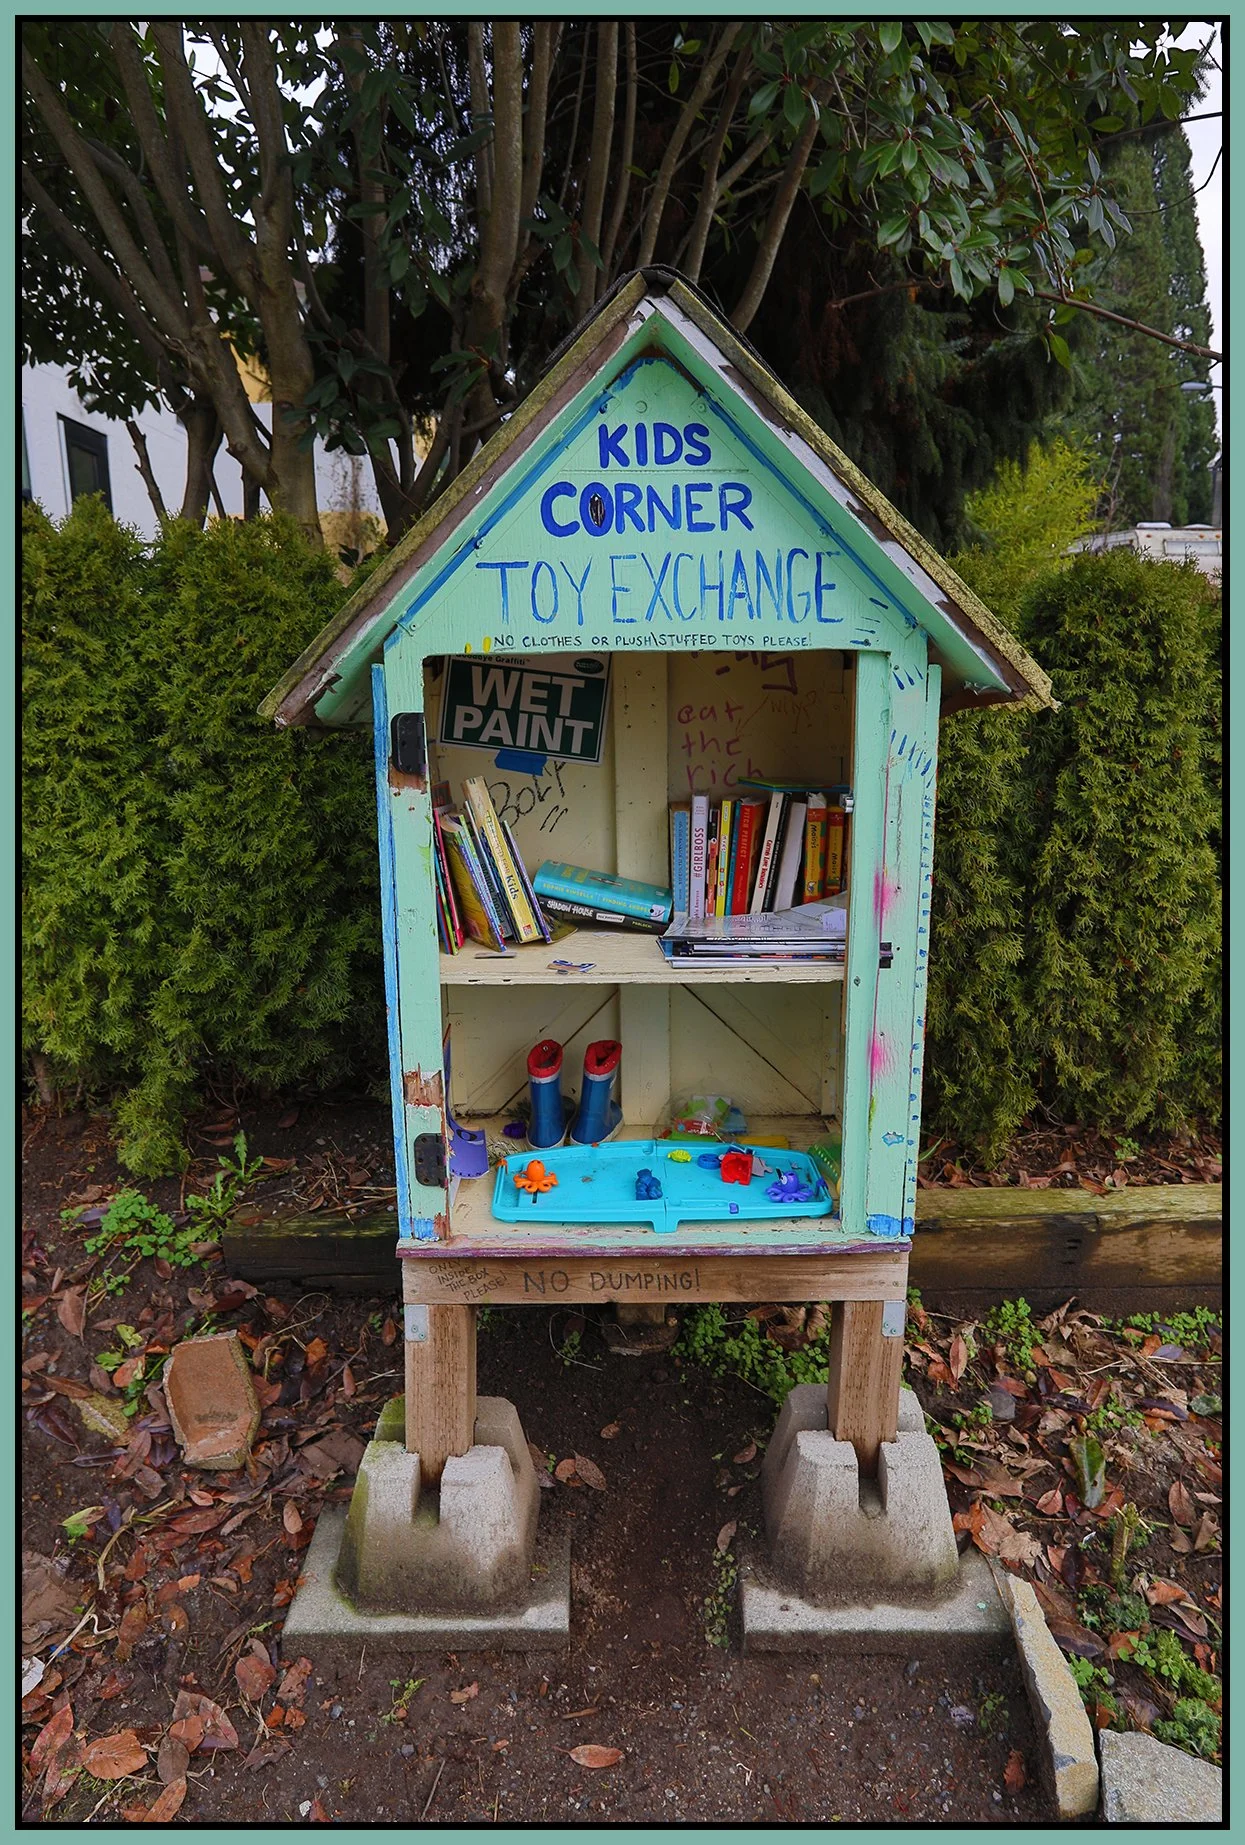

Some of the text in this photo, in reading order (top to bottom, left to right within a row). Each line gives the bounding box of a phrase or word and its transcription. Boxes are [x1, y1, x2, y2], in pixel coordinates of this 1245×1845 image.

[599, 423, 712, 469] KIDS
[540, 481, 755, 538] CORNER
[476, 547, 844, 626] TOY EXCHANGE
[494, 634, 515, 648] NO
[522, 636, 582, 648] CLOTHES
[591, 636, 609, 646] OR
[722, 634, 755, 646] TOYS
[763, 632, 813, 647] PLEASE!
[471, 665, 585, 717] WET
[677, 701, 744, 725] eat
[453, 704, 594, 755] PAINT
[681, 731, 743, 757] the
[686, 758, 764, 791] rich
[810, 824, 819, 849] Maisy's
[693, 827, 704, 878] #GIRLBOSS
[505, 875, 519, 900] Kids
[546, 900, 594, 917] SHADOW HOUSE
[429, 1257, 461, 1275] ONLY
[438, 1266, 471, 1285] INSIDE
[446, 1267, 489, 1292] THE BOX
[464, 1270, 510, 1301] PLEASE!
[523, 1268, 701, 1294] NO DUMPING!
